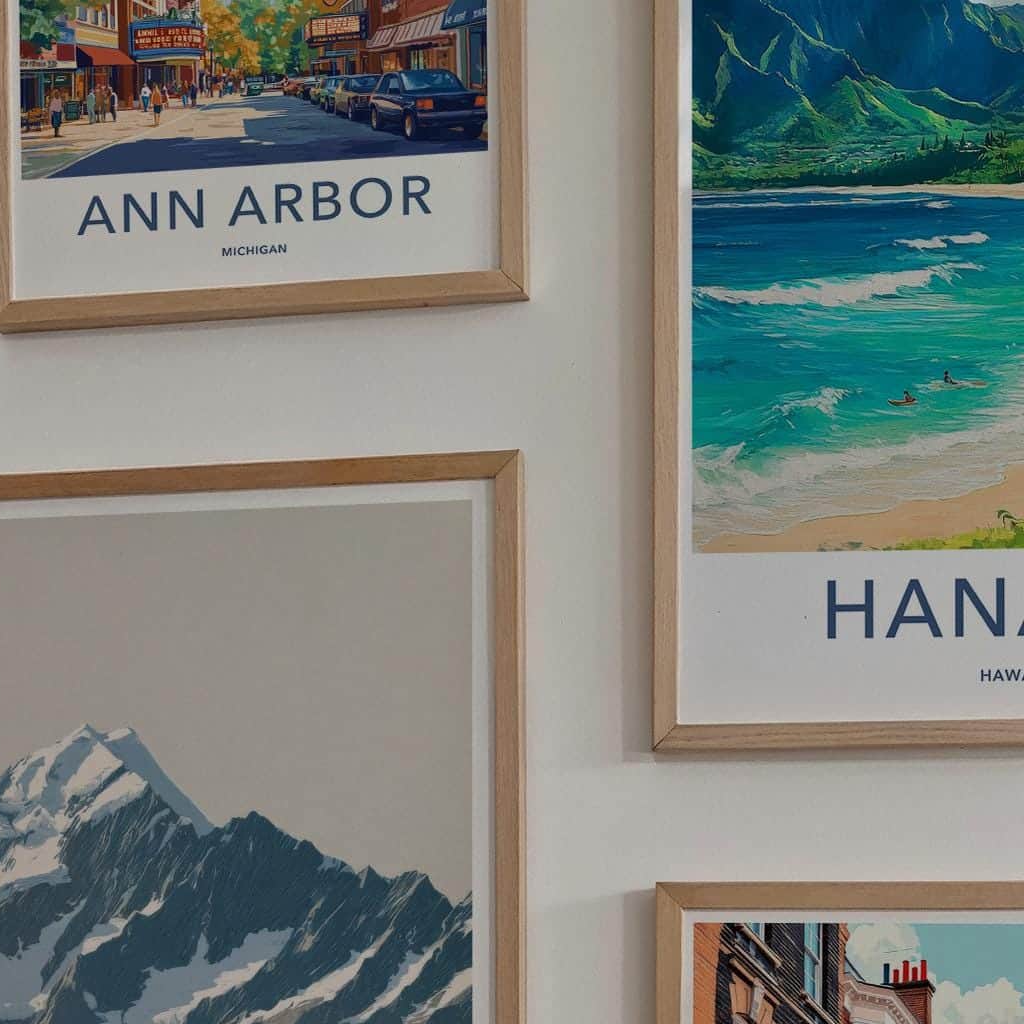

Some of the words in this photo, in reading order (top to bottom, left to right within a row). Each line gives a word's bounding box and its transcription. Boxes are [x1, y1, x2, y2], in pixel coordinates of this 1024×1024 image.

[77, 189, 205, 236] ANN
[228, 175, 432, 227] ARBOR
[221, 243, 288, 257] MICHIGAN
[827, 577, 1024, 639] HAN
